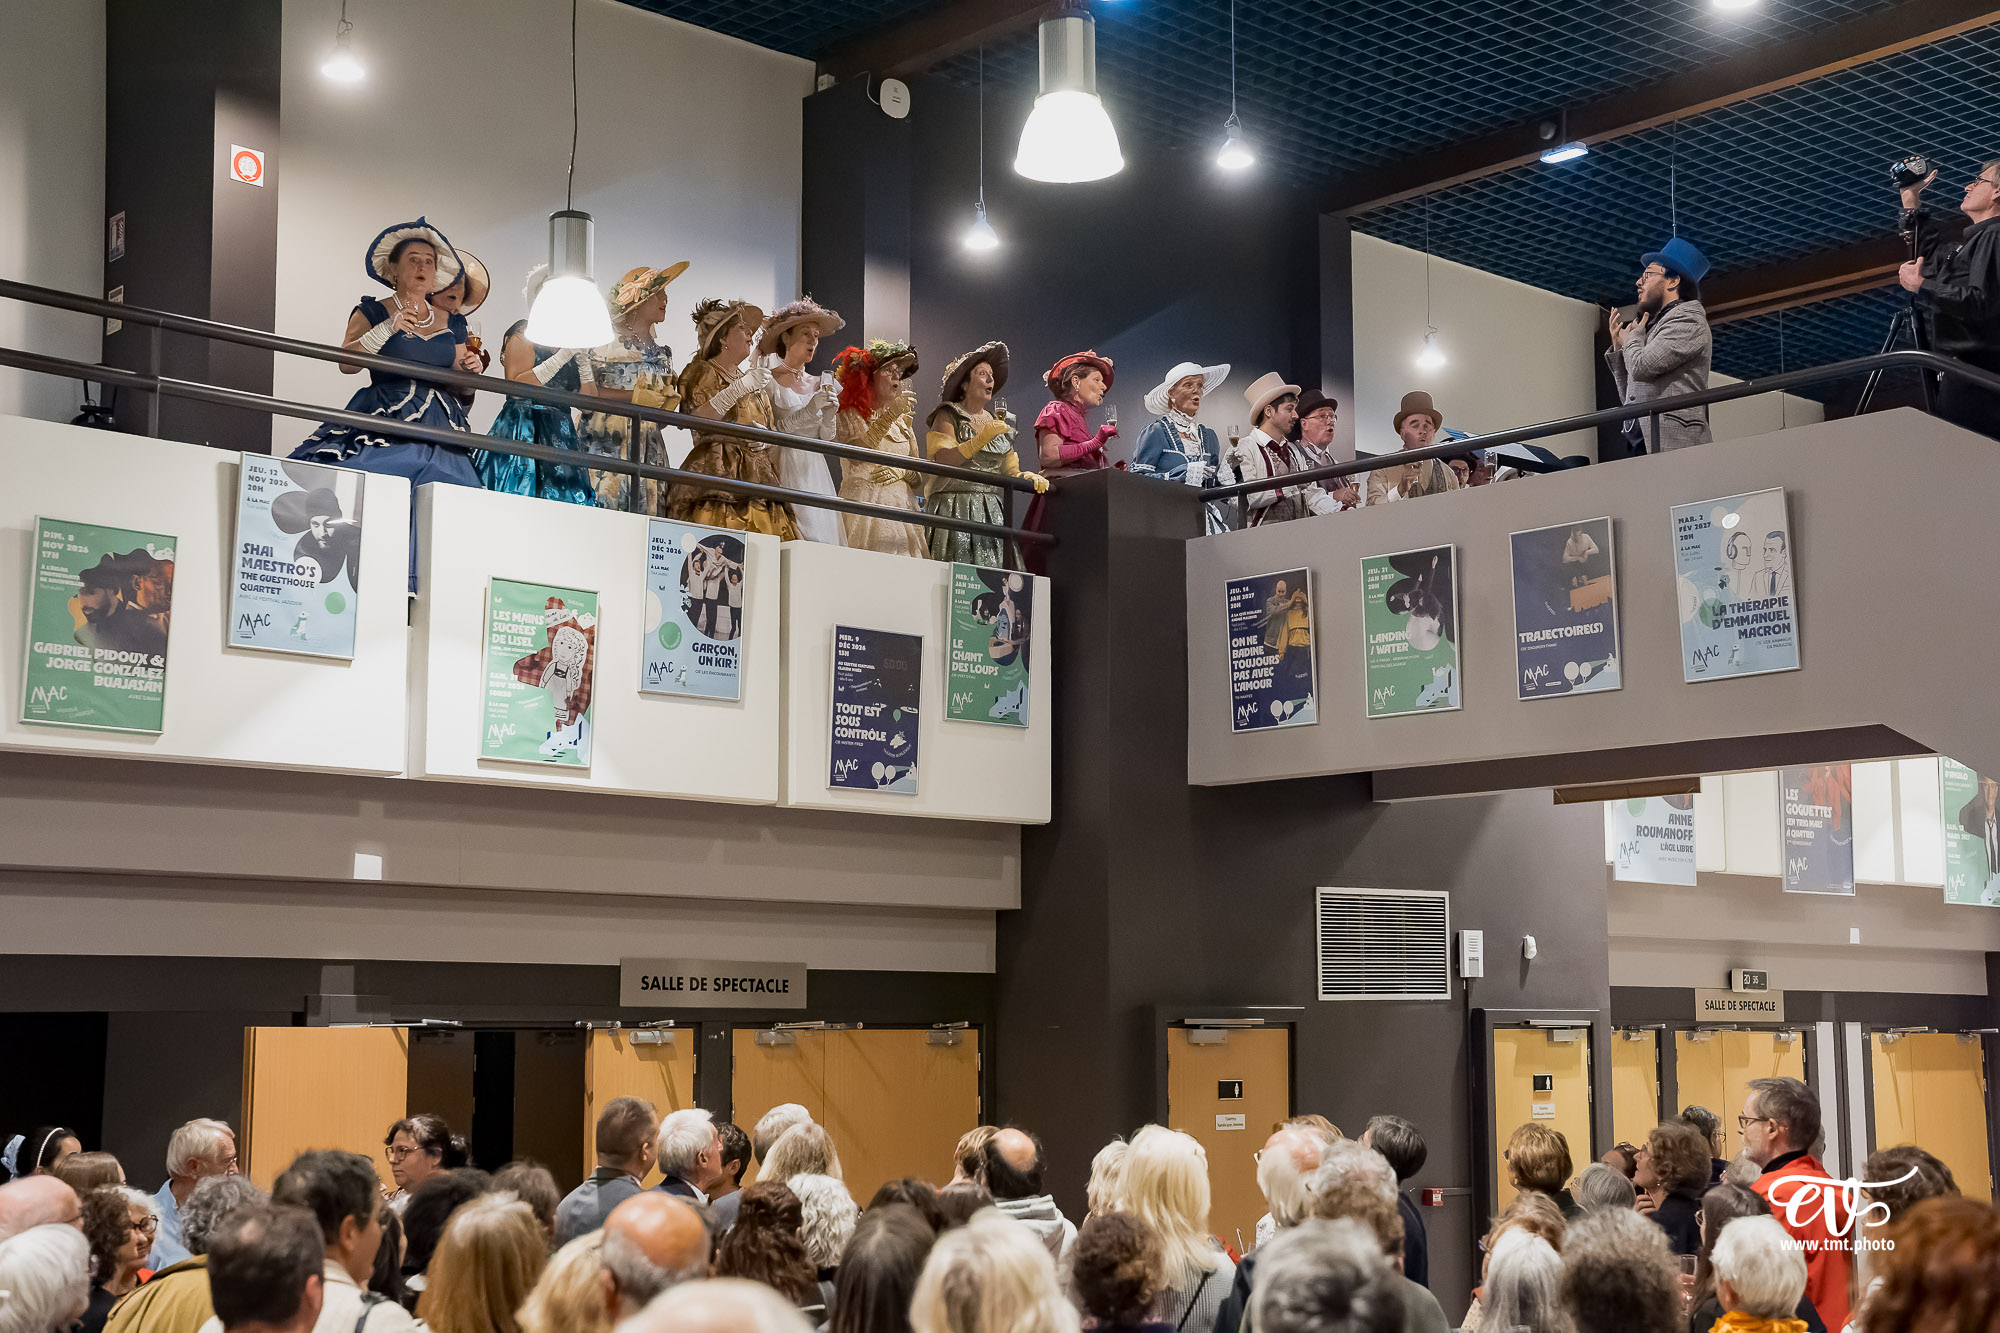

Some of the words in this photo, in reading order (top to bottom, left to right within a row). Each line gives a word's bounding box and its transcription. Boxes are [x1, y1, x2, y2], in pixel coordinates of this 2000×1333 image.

[248, 466, 266, 474] JEU.
[248, 475, 266, 483] NOV
[269, 478, 288, 487] 2026
[248, 484, 264, 492] 20H
[1678, 516, 1697, 524] MAR.
[1694, 521, 1711, 530] 2027
[43, 530, 64, 540] DIM.
[1680, 533, 1694, 541] 20H
[42, 541, 64, 550] NOV
[66, 544, 89, 553] 2026
[243, 543, 273, 557] SHAI
[242, 557, 316, 577] MAESTRO'S
[241, 572, 258, 580] THE
[260, 575, 314, 588] GUESTHOUSE
[240, 583, 282, 595] QUARTET
[1712, 605, 1727, 616] LA
[1729, 596, 1788, 614] THÉRAPIE
[239, 613, 271, 636] MAC
[493, 610, 511, 621] LES
[512, 612, 544, 625] MAINS
[1712, 610, 1790, 630] D'EMMANUEL
[493, 620, 536, 636] SUCRÉES
[1519, 623, 1603, 643] TRAJECTOIRE(S)
[1738, 623, 1790, 639] MACRON
[492, 633, 506, 644] DE
[508, 635, 534, 648] LISEL
[953, 639, 963, 648] LE
[1232, 638, 1245, 648] ON
[1247, 635, 1258, 646] NE
[34, 642, 92, 658] GABRIEL
[94, 648, 148, 665] PIDOUX
[151, 655, 164, 667] &
[692, 642, 737, 658] GARÇON,
[1232, 646, 1264, 659] BADINE
[1370, 646, 1374, 655] /
[1376, 642, 1409, 654] WATER
[1693, 645, 1720, 667] MAC
[698, 656, 713, 666] UN
[715, 657, 732, 668] KIR
[734, 659, 737, 669] !
[952, 651, 983, 662] CHANT
[1233, 654, 1280, 670] TOUJOURS
[46, 657, 91, 672] JORGE
[94, 662, 164, 680] GONZÁLEZ
[649, 662, 674, 681] MAC
[952, 662, 968, 672] DES
[970, 664, 999, 676] LOUPS
[1234, 670, 1250, 681] PAS
[1252, 667, 1274, 678] AVEC
[1524, 664, 1549, 686] MAC
[94, 676, 162, 693] BUAJASÁN
[1234, 679, 1272, 692] L'AMOUR
[31, 686, 68, 710] MAC
[952, 692, 973, 711] MAC
[1374, 685, 1395, 705] MAC
[836, 703, 863, 715] TOUT
[864, 706, 881, 717] EST
[1238, 702, 1258, 722] MAC
[835, 715, 860, 727] SOUS
[488, 723, 516, 744] MAC
[835, 727, 886, 741] CONTRÔLE
[835, 759, 858, 778] MAC
[1786, 788, 1799, 801] LES
[1786, 803, 1832, 818] GOGUETTES
[1668, 813, 1692, 826] ANNE
[1809, 820, 1823, 828] MAIS
[1636, 825, 1693, 841] ROUMANOFF
[1620, 840, 1640, 864] MAC
[1661, 842, 1676, 852] L'ÂGE
[1677, 844, 1693, 853] LIBRE
[1789, 857, 1808, 880] MAC
[1948, 874, 1966, 896] MAC
[641, 976, 683, 990] SALLE
[690, 977, 707, 991] DE
[713, 977, 788, 993] SPECTACLE
[1705, 1000, 1725, 1010] SALLE
[1728, 1001, 1736, 1010] DE
[1739, 1001, 1775, 1011] SPECTACLE
